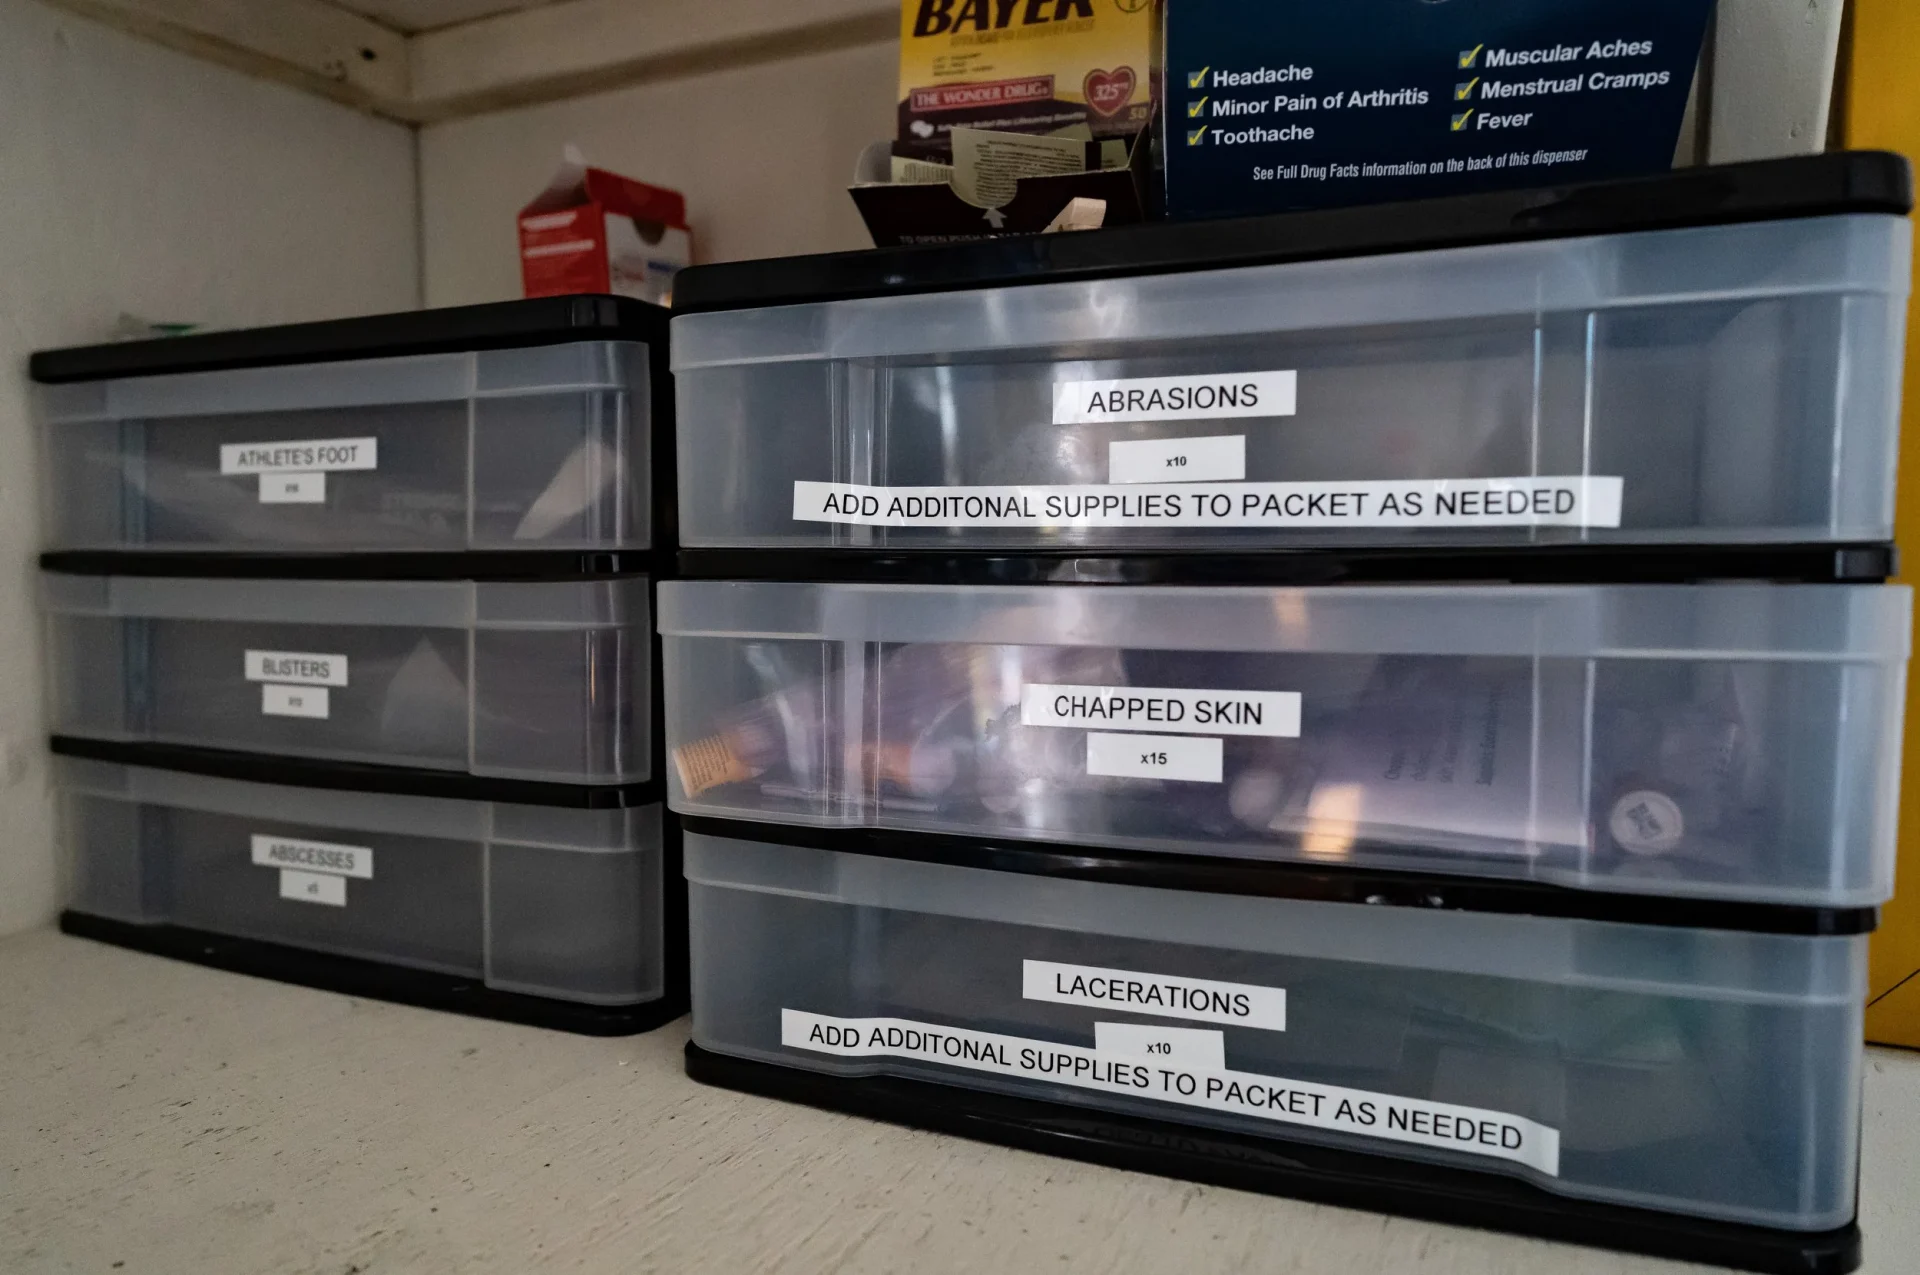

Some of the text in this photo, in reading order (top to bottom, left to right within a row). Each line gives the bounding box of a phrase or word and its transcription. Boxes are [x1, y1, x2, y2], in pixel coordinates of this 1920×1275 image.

[1485, 39, 1653, 68] Muscular Aches
[1213, 65, 1313, 88] Headache
[1480, 71, 1670, 99] Menstrual Cramps
[916, 92, 938, 106] THE
[1212, 88, 1429, 117] Minor Pain of Arthritis
[1476, 111, 1533, 130] Fever
[1211, 124, 1315, 145] Toothache
[1253, 149, 1588, 181] See Full Drug Facts information on the back of this dispenser
[1087, 383, 1258, 413] ABRASIONS
[237, 445, 358, 467] ATHLETE'S FOOT
[1166, 456, 1187, 467] x10
[823, 489, 1575, 519] ADD ADDITONAL SUPPLIES TO PACKET AS NEEDED
[262, 657, 331, 679] BLISTERS
[1054, 695, 1262, 725] CHAPPED SKIN
[1140, 752, 1167, 765] x15
[268, 844, 355, 871] ABSCESSES
[1056, 973, 1250, 1017] LACERATIONS
[1147, 1043, 1171, 1055] x10
[809, 1023, 1523, 1150] ADD ADDITONAL SUPPLIES TO PACKET AS NEEDED
